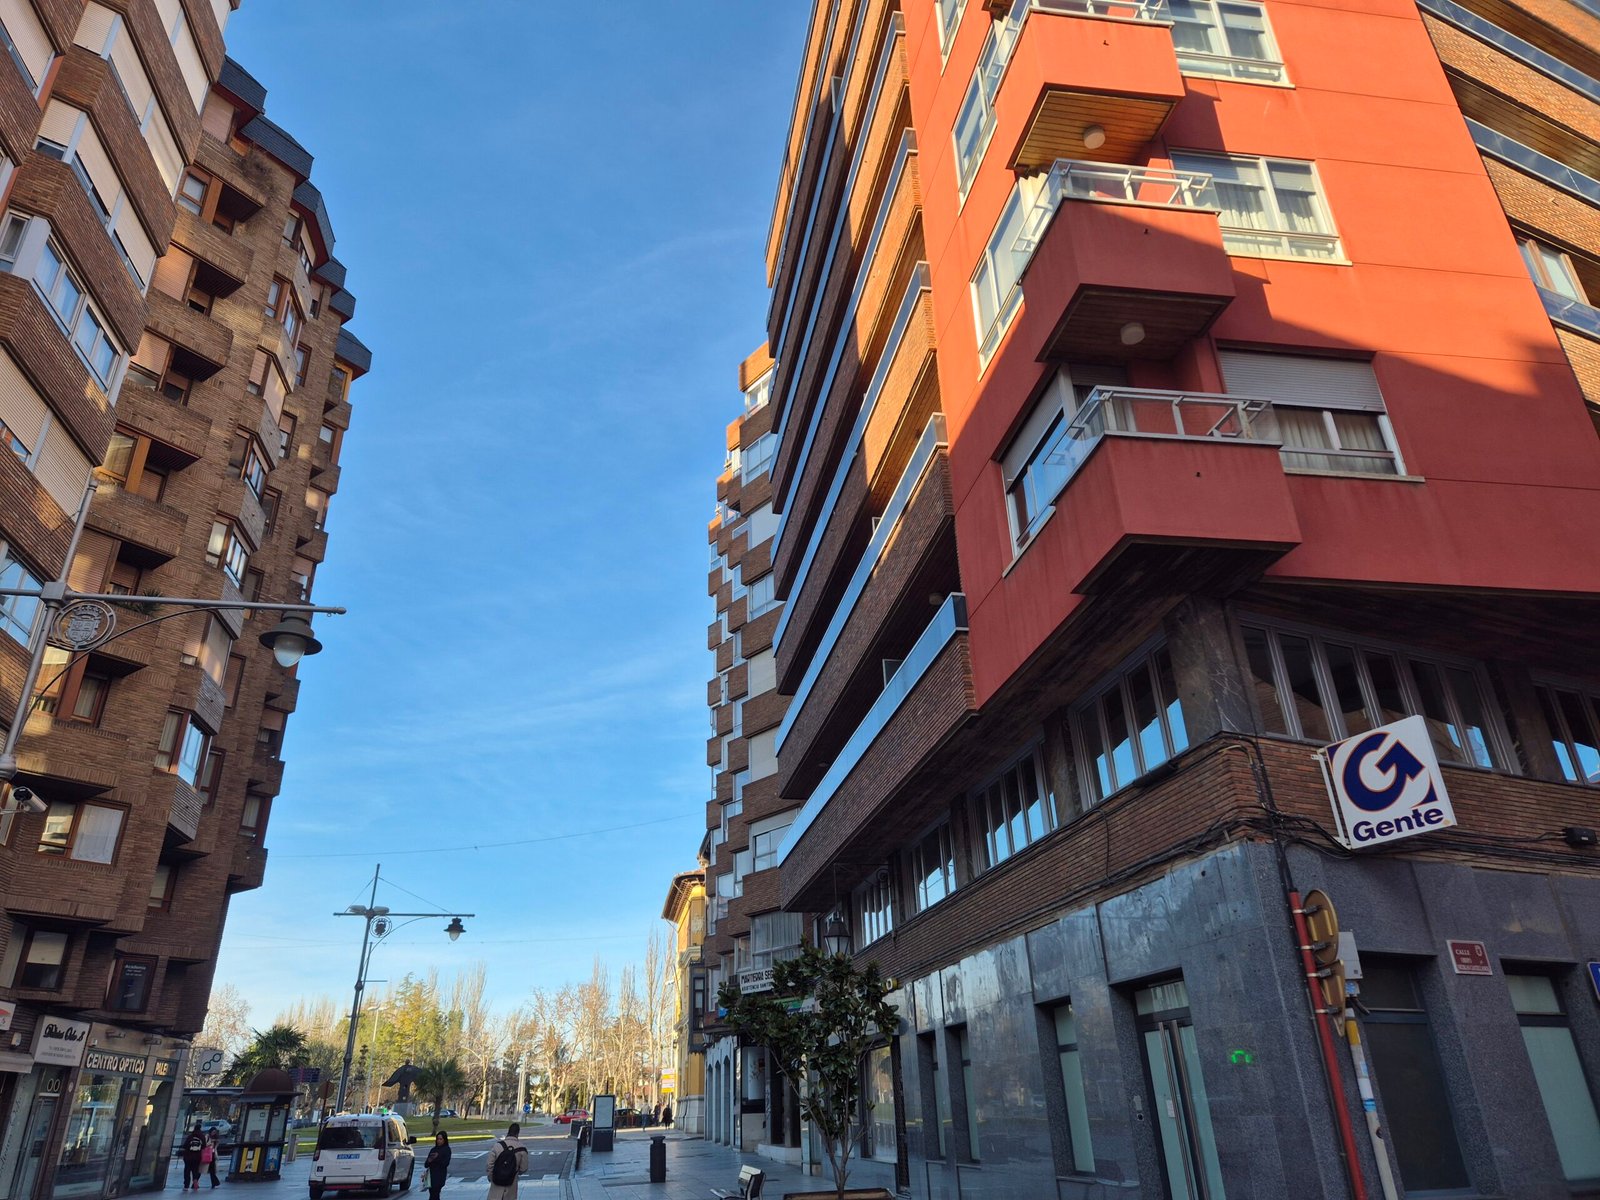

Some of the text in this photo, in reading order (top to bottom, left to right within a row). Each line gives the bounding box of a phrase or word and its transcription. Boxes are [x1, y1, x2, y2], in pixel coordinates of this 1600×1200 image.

[1353, 808, 1444, 842] Gente
[86, 1053, 118, 1070] CENTRO
[118, 1056, 145, 1074] OPTICO
